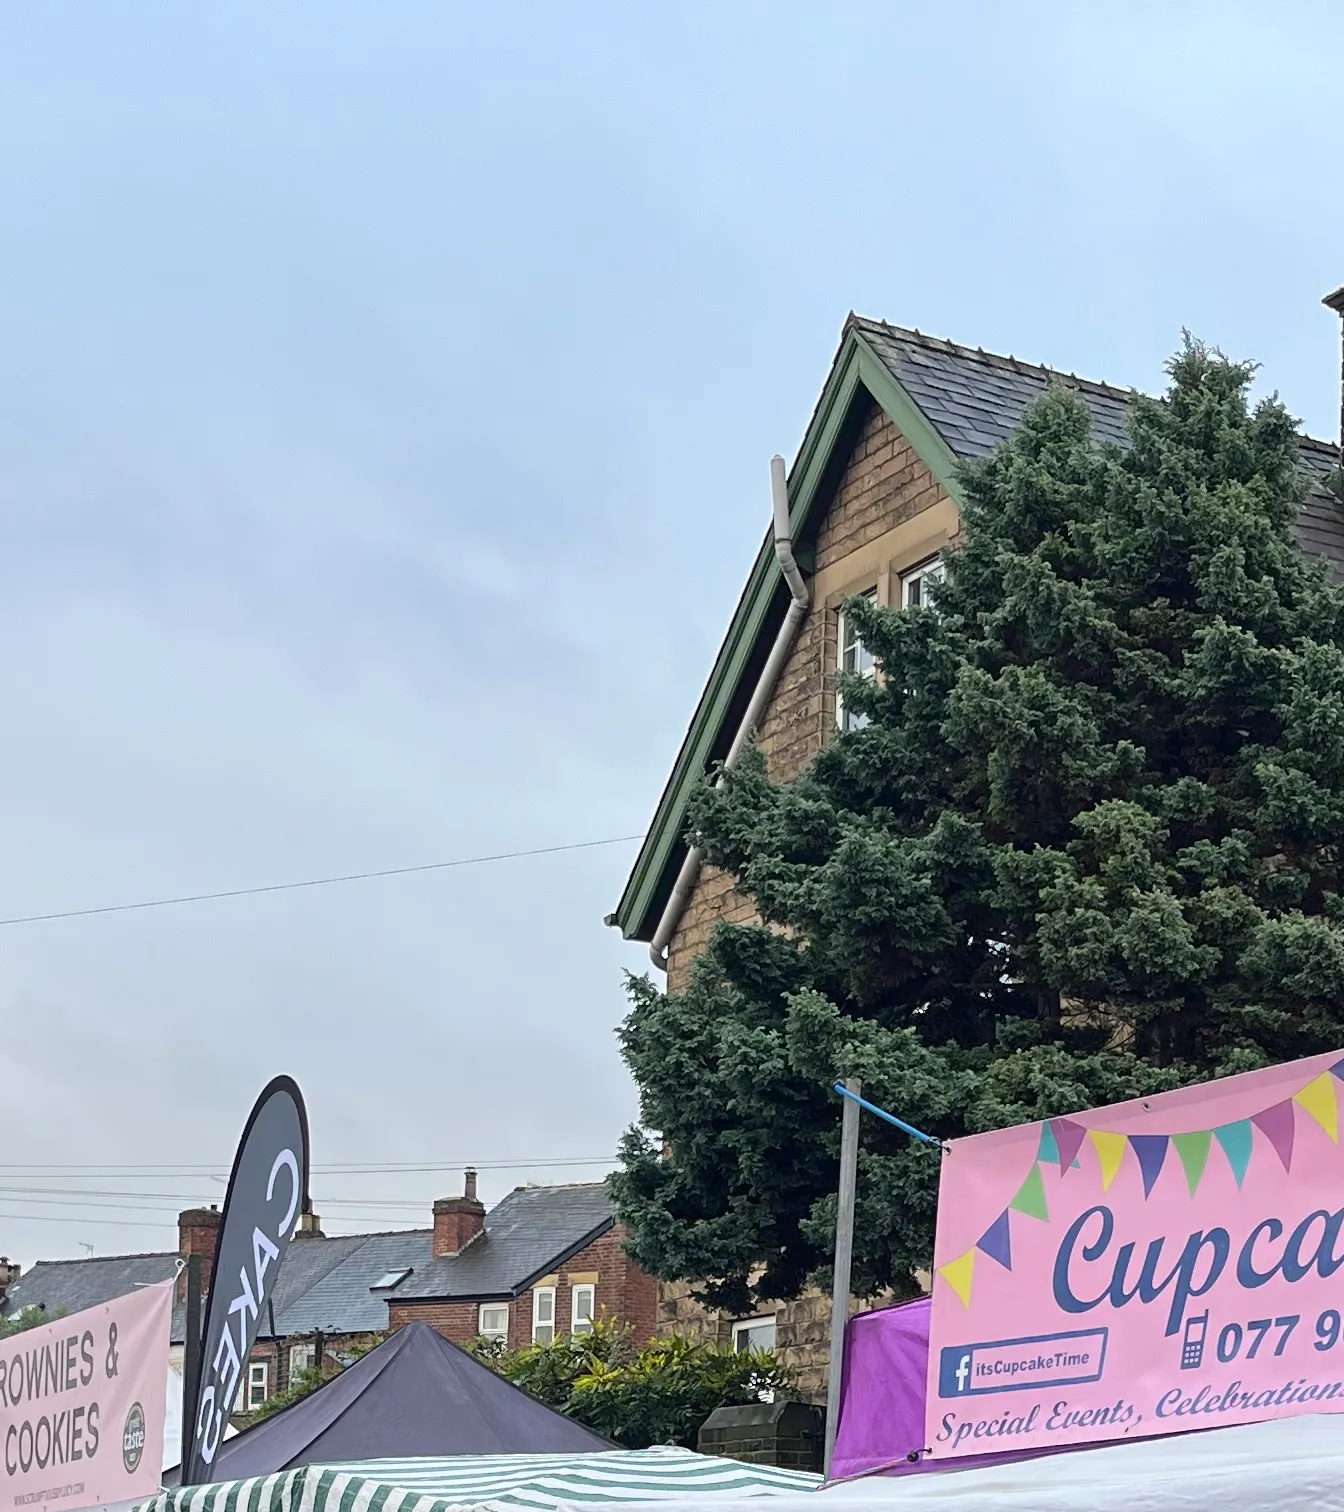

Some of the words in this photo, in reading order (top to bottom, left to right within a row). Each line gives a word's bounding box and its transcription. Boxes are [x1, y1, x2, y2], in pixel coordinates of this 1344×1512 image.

[106, 1322, 118, 1379] &
[1217, 1314, 1301, 1362] 077
[976, 1352, 1090, 1376] itsCupcakeTime
[6, 1402, 99, 1476] COOKIES
[124, 1431, 144, 1451] taste
[936, 1404, 1040, 1448] Special
[1045, 1400, 1143, 1428] Events,
